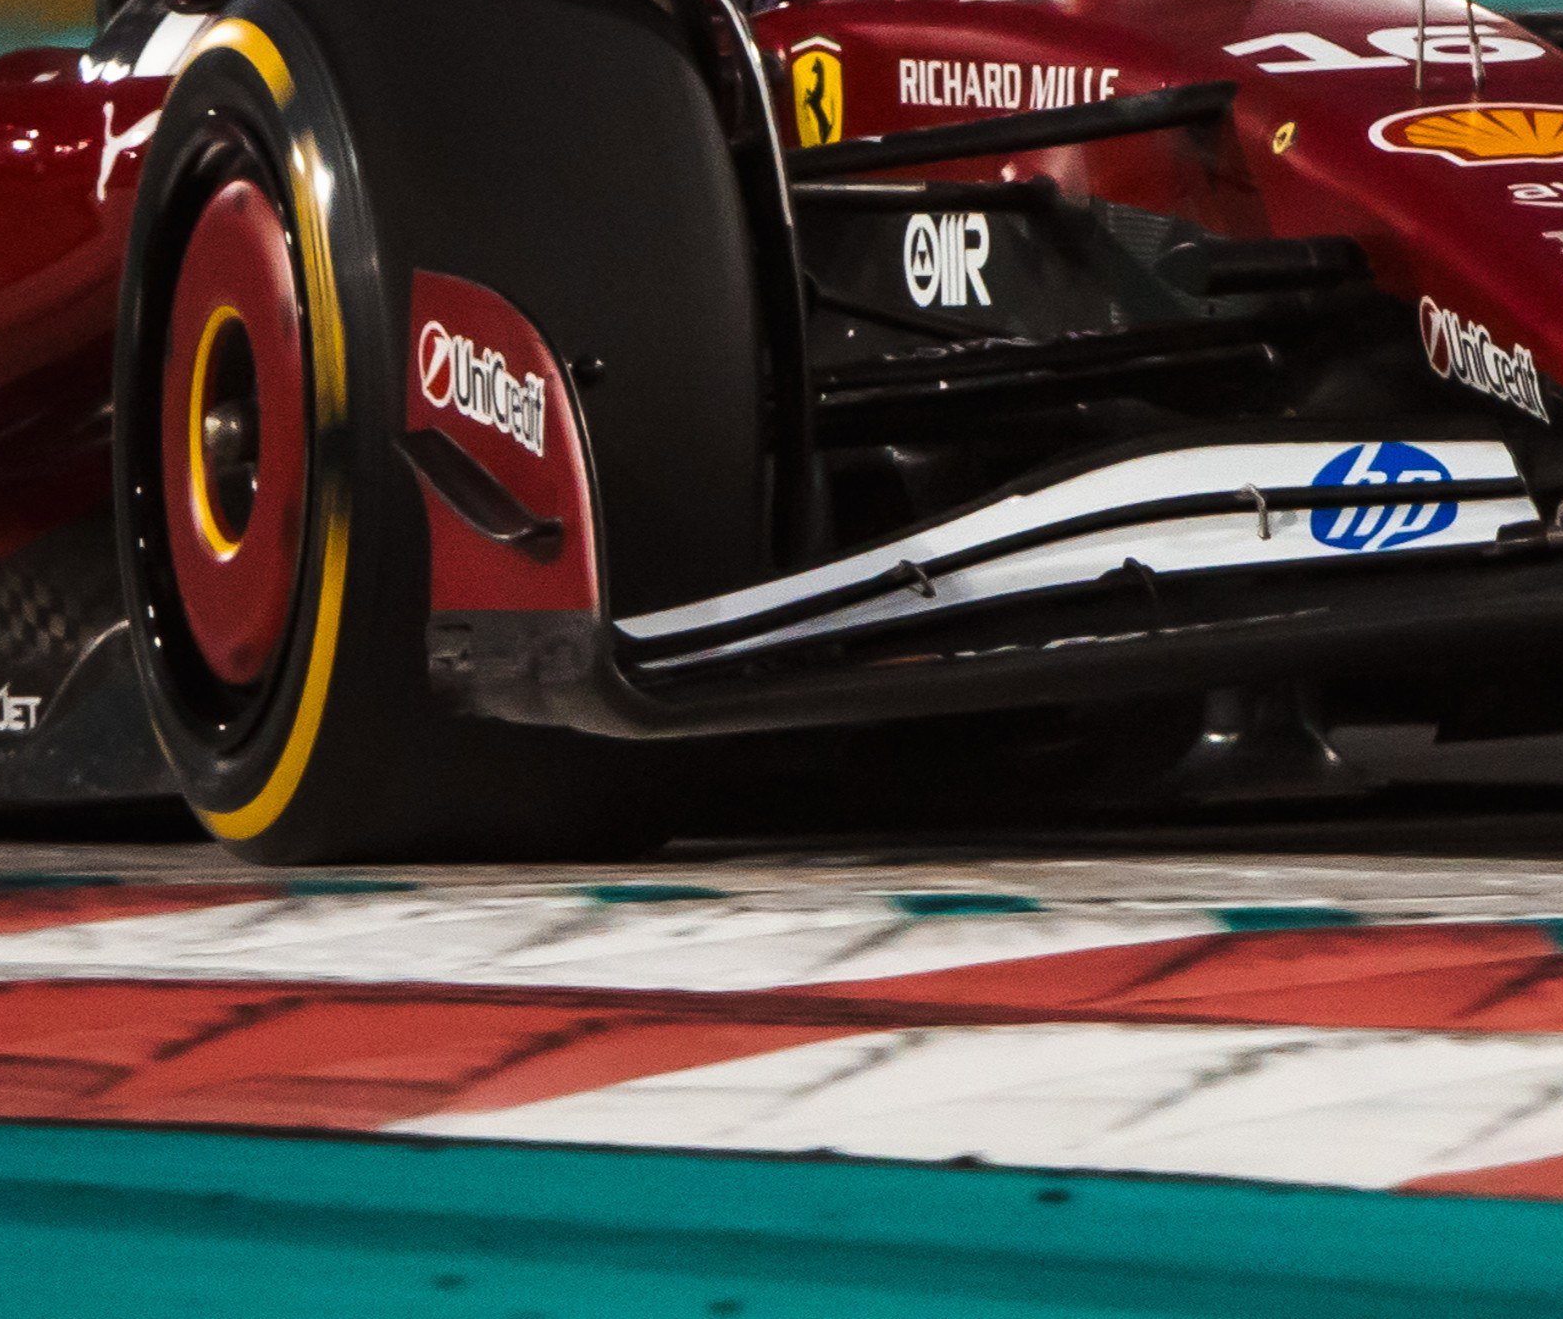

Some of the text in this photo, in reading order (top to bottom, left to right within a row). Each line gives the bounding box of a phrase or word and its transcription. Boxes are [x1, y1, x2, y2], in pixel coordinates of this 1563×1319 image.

[899, 59, 1023, 109] RICHARD
[1222, 25, 1546, 73] 16
[453, 334, 546, 458] UniCredit
[1441, 308, 1551, 425] UniCredit
[1326, 441, 1442, 552] hp
